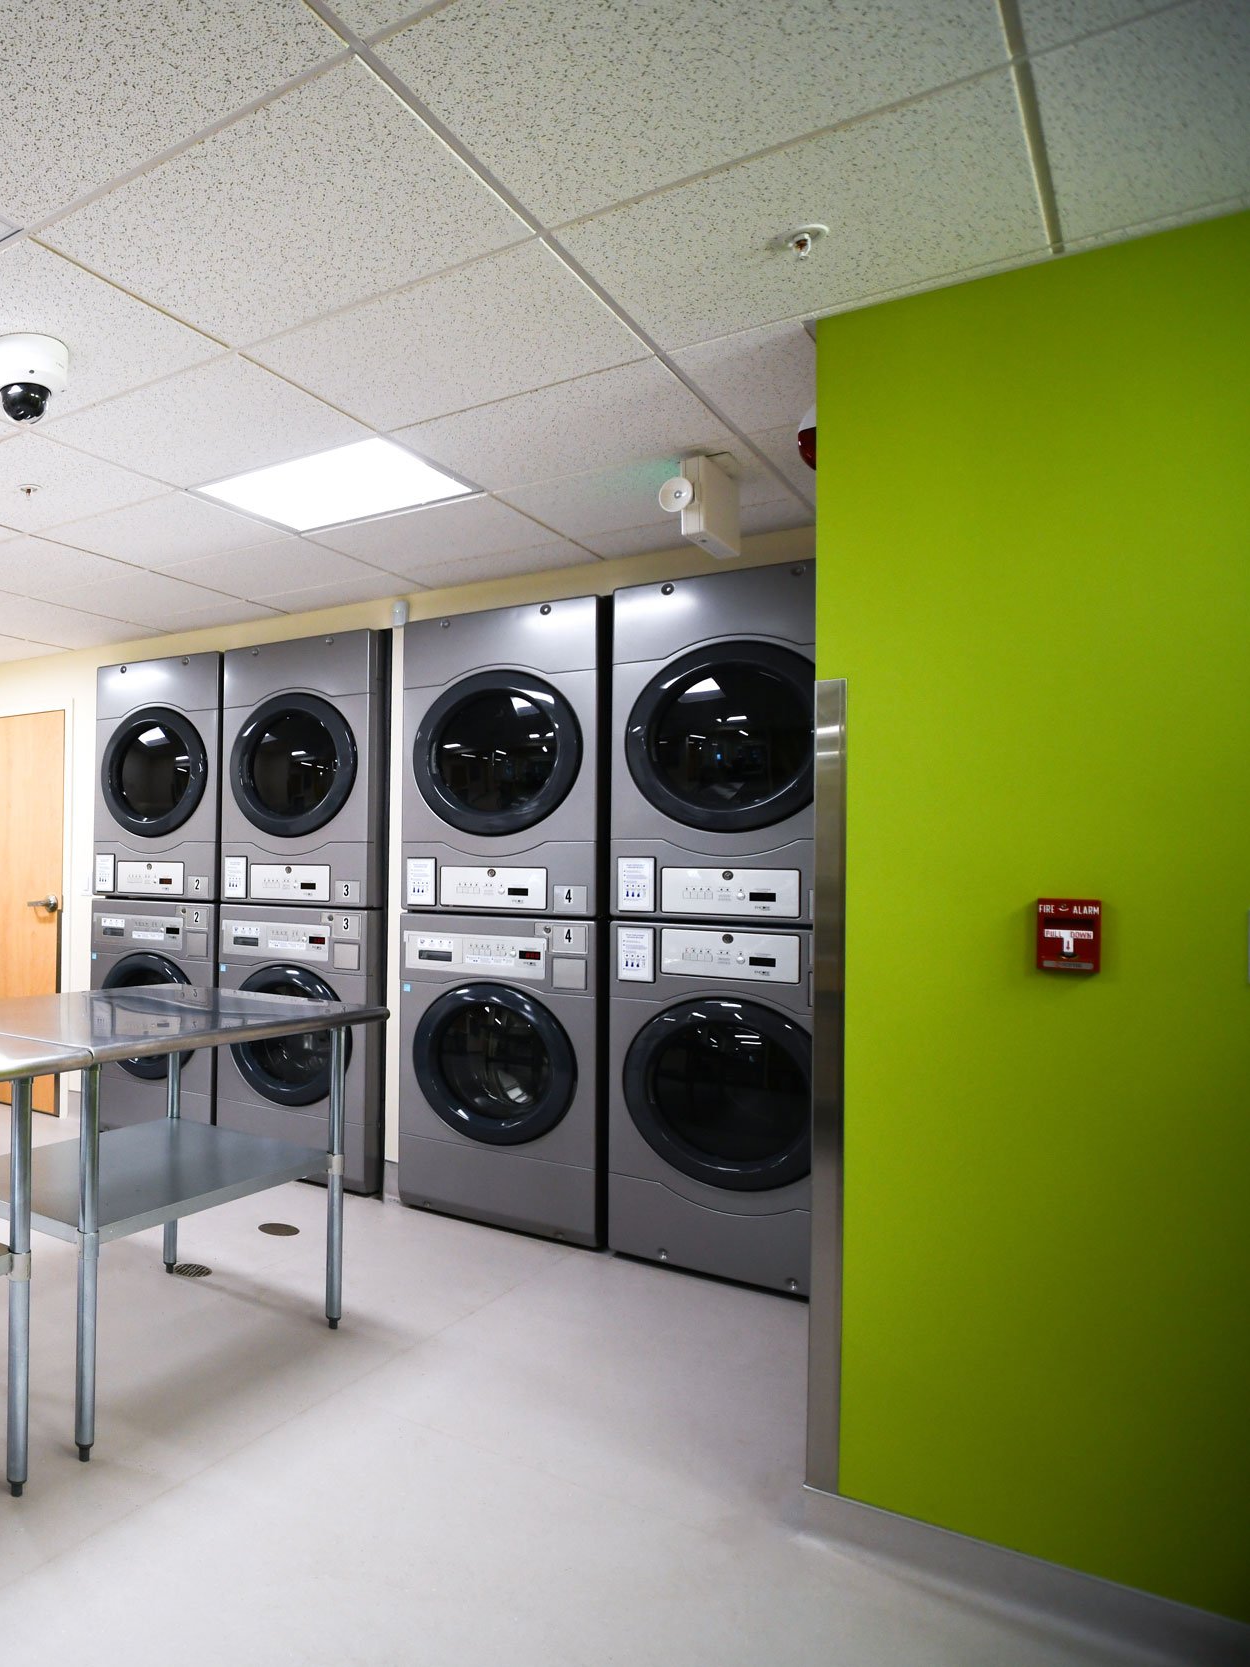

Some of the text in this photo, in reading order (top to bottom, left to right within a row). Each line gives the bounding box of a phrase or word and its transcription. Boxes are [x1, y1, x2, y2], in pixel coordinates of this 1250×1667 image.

[194, 879, 200, 890] 2
[343, 884, 350, 896] 3
[565, 889, 572, 903] 4
[1039, 904, 1100, 915] FIRE ALARM
[194, 911, 200, 923] 2
[343, 917, 350, 930] 3
[564, 929, 572, 943] 4
[1045, 930, 1093, 939] PULL DOWN
